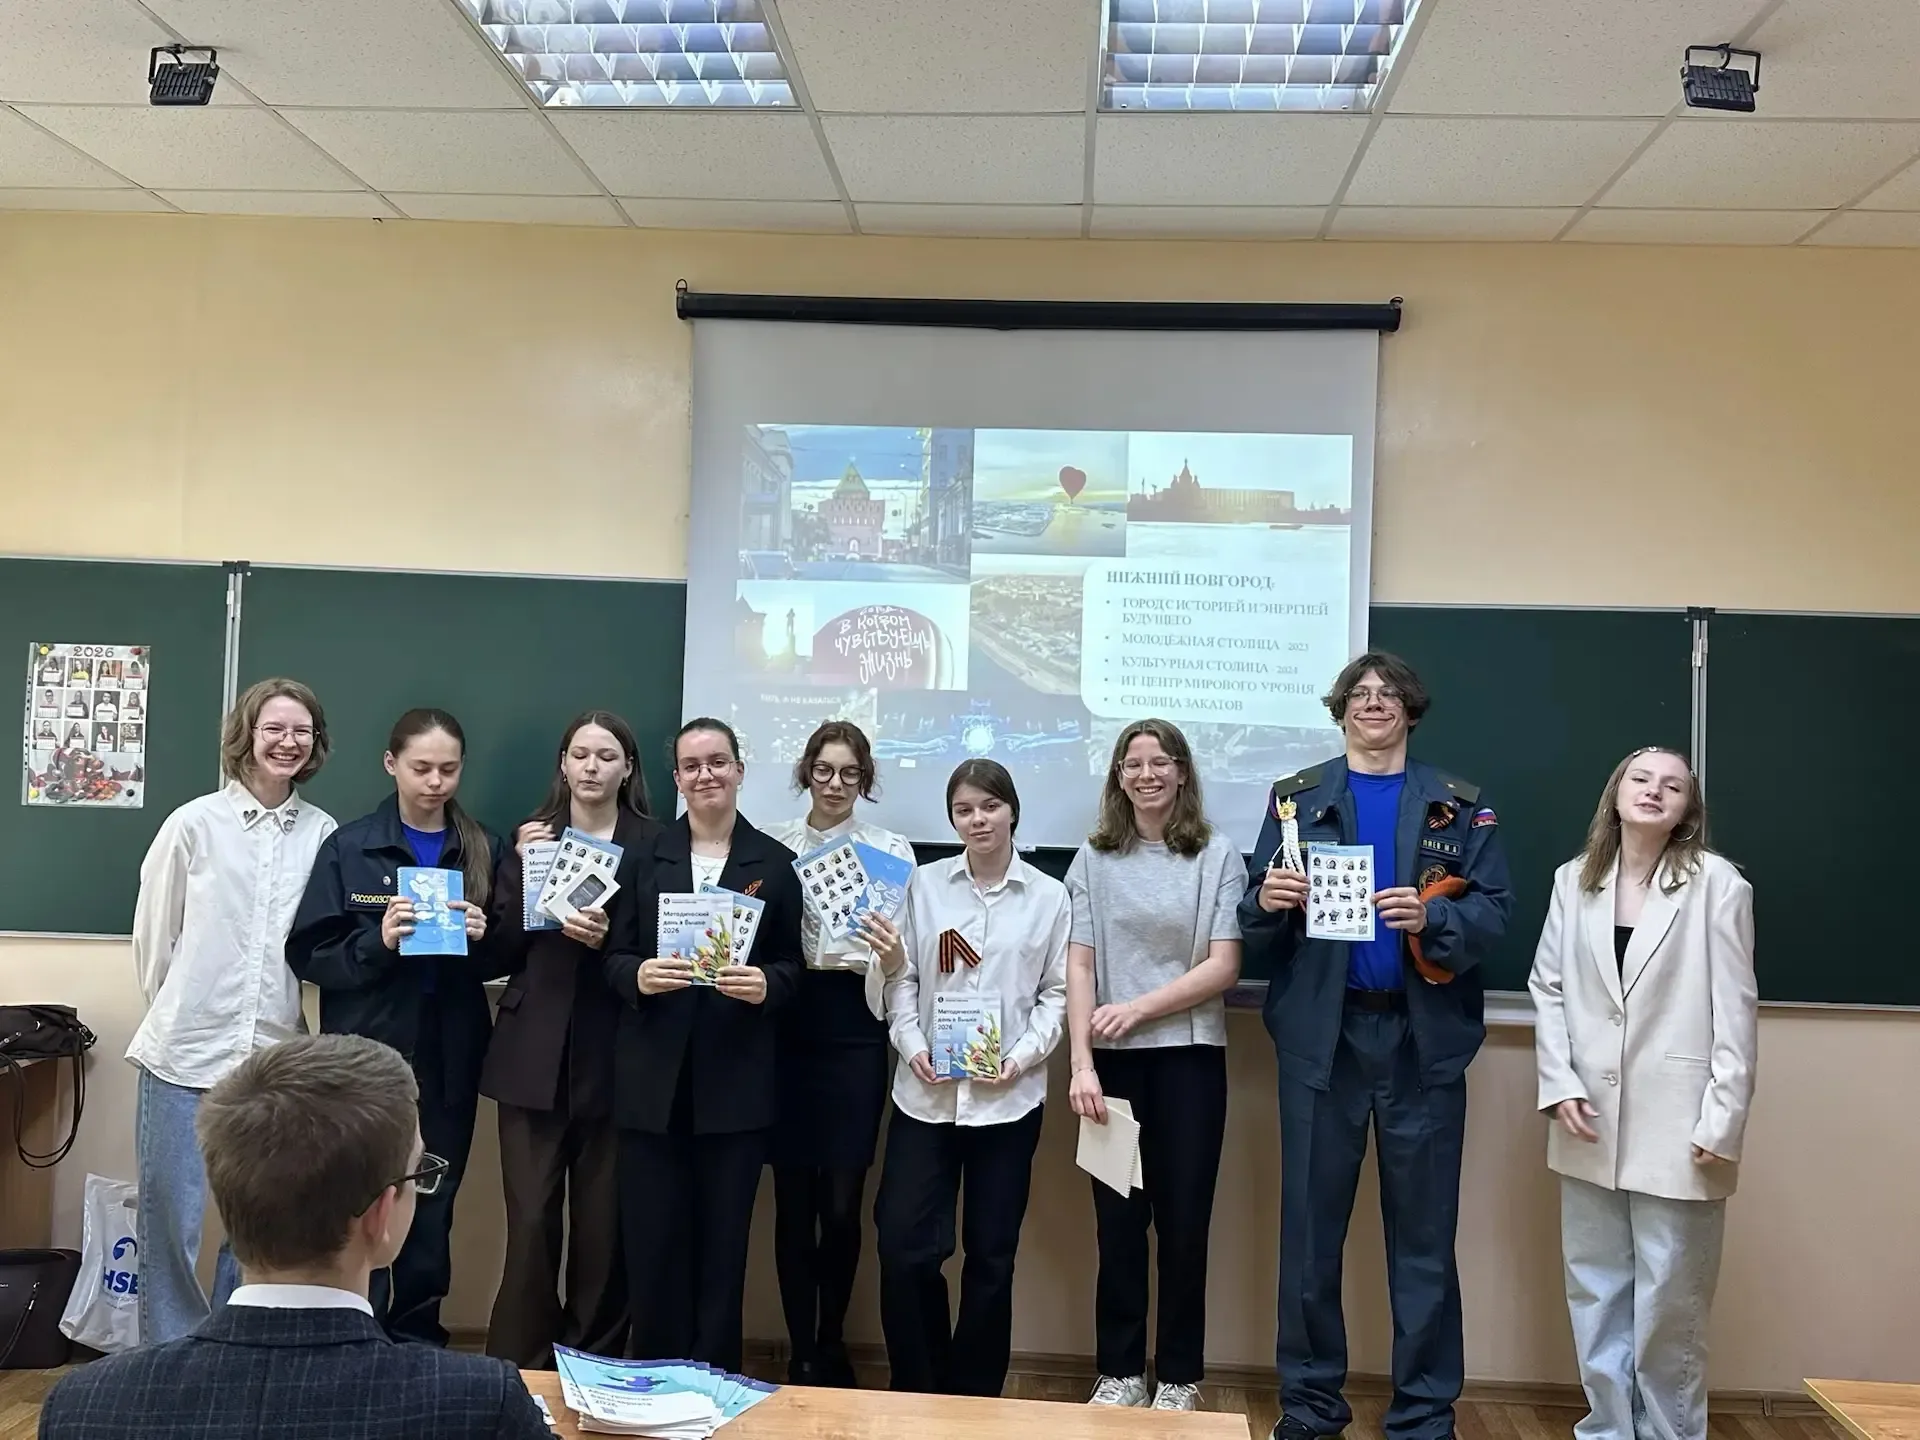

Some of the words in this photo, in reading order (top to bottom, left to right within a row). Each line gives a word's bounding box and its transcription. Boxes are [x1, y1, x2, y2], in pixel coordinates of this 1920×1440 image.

[1106, 570, 1181, 586] НИЖНИЙ
[1122, 598, 1164, 611] ГОРОД
[1165, 599, 1175, 610] С
[1176, 597, 1246, 613] ИСТОРИЕЙ
[1248, 602, 1259, 613] И
[1260, 601, 1329, 616] ЭНЕРГИЕЙ
[1121, 613, 1192, 627] БУДУЩЕГО
[73, 646, 114, 658] 2026
[1217, 637, 1280, 652] СТОЛИЦА
[859, 649, 913, 685] ЖИЗНЬ
[1121, 656, 1204, 671] КУЛЬТУРНАЯ
[1206, 660, 1269, 675] СТОЛИЦА
[1140, 676, 1183, 690] ЦЕНТР
[1185, 678, 1257, 692] МИРОВОГО
[1260, 682, 1315, 696] УРОВНЯ
[1120, 695, 1182, 709] СТОЛИЦА
[1184, 698, 1244, 712] ЗАКАТОВ
